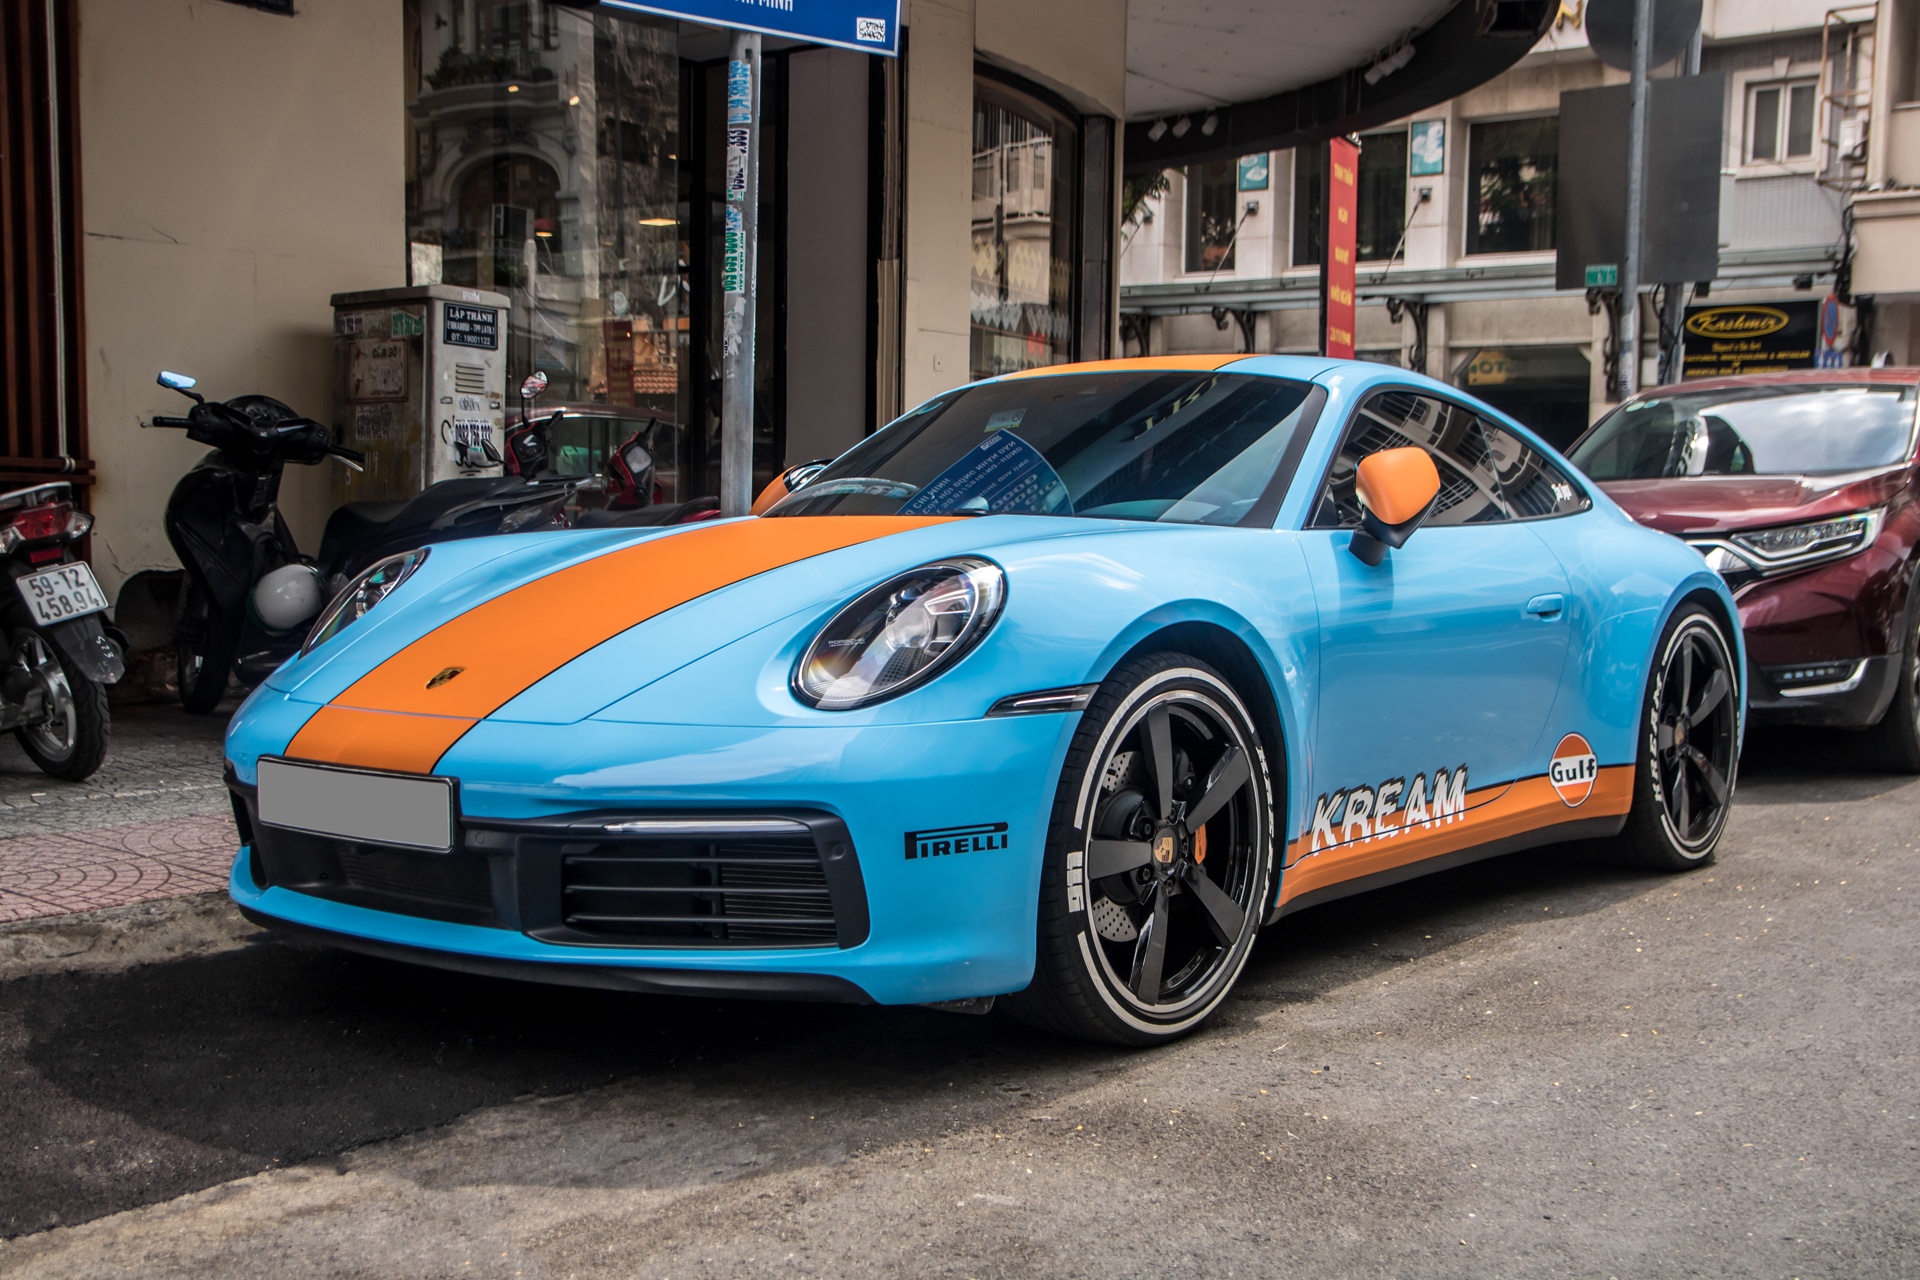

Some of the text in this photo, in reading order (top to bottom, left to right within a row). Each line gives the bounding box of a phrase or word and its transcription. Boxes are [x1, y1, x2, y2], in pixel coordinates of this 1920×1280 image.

[1697, 313, 1778, 332] Kashmir
[28, 568, 85, 598] 59-T2
[36, 588, 100, 620] 458.94
[1551, 758, 1597, 783] Gulf
[1311, 762, 1468, 857] KREAM
[904, 821, 1008, 860] PIRELLI
